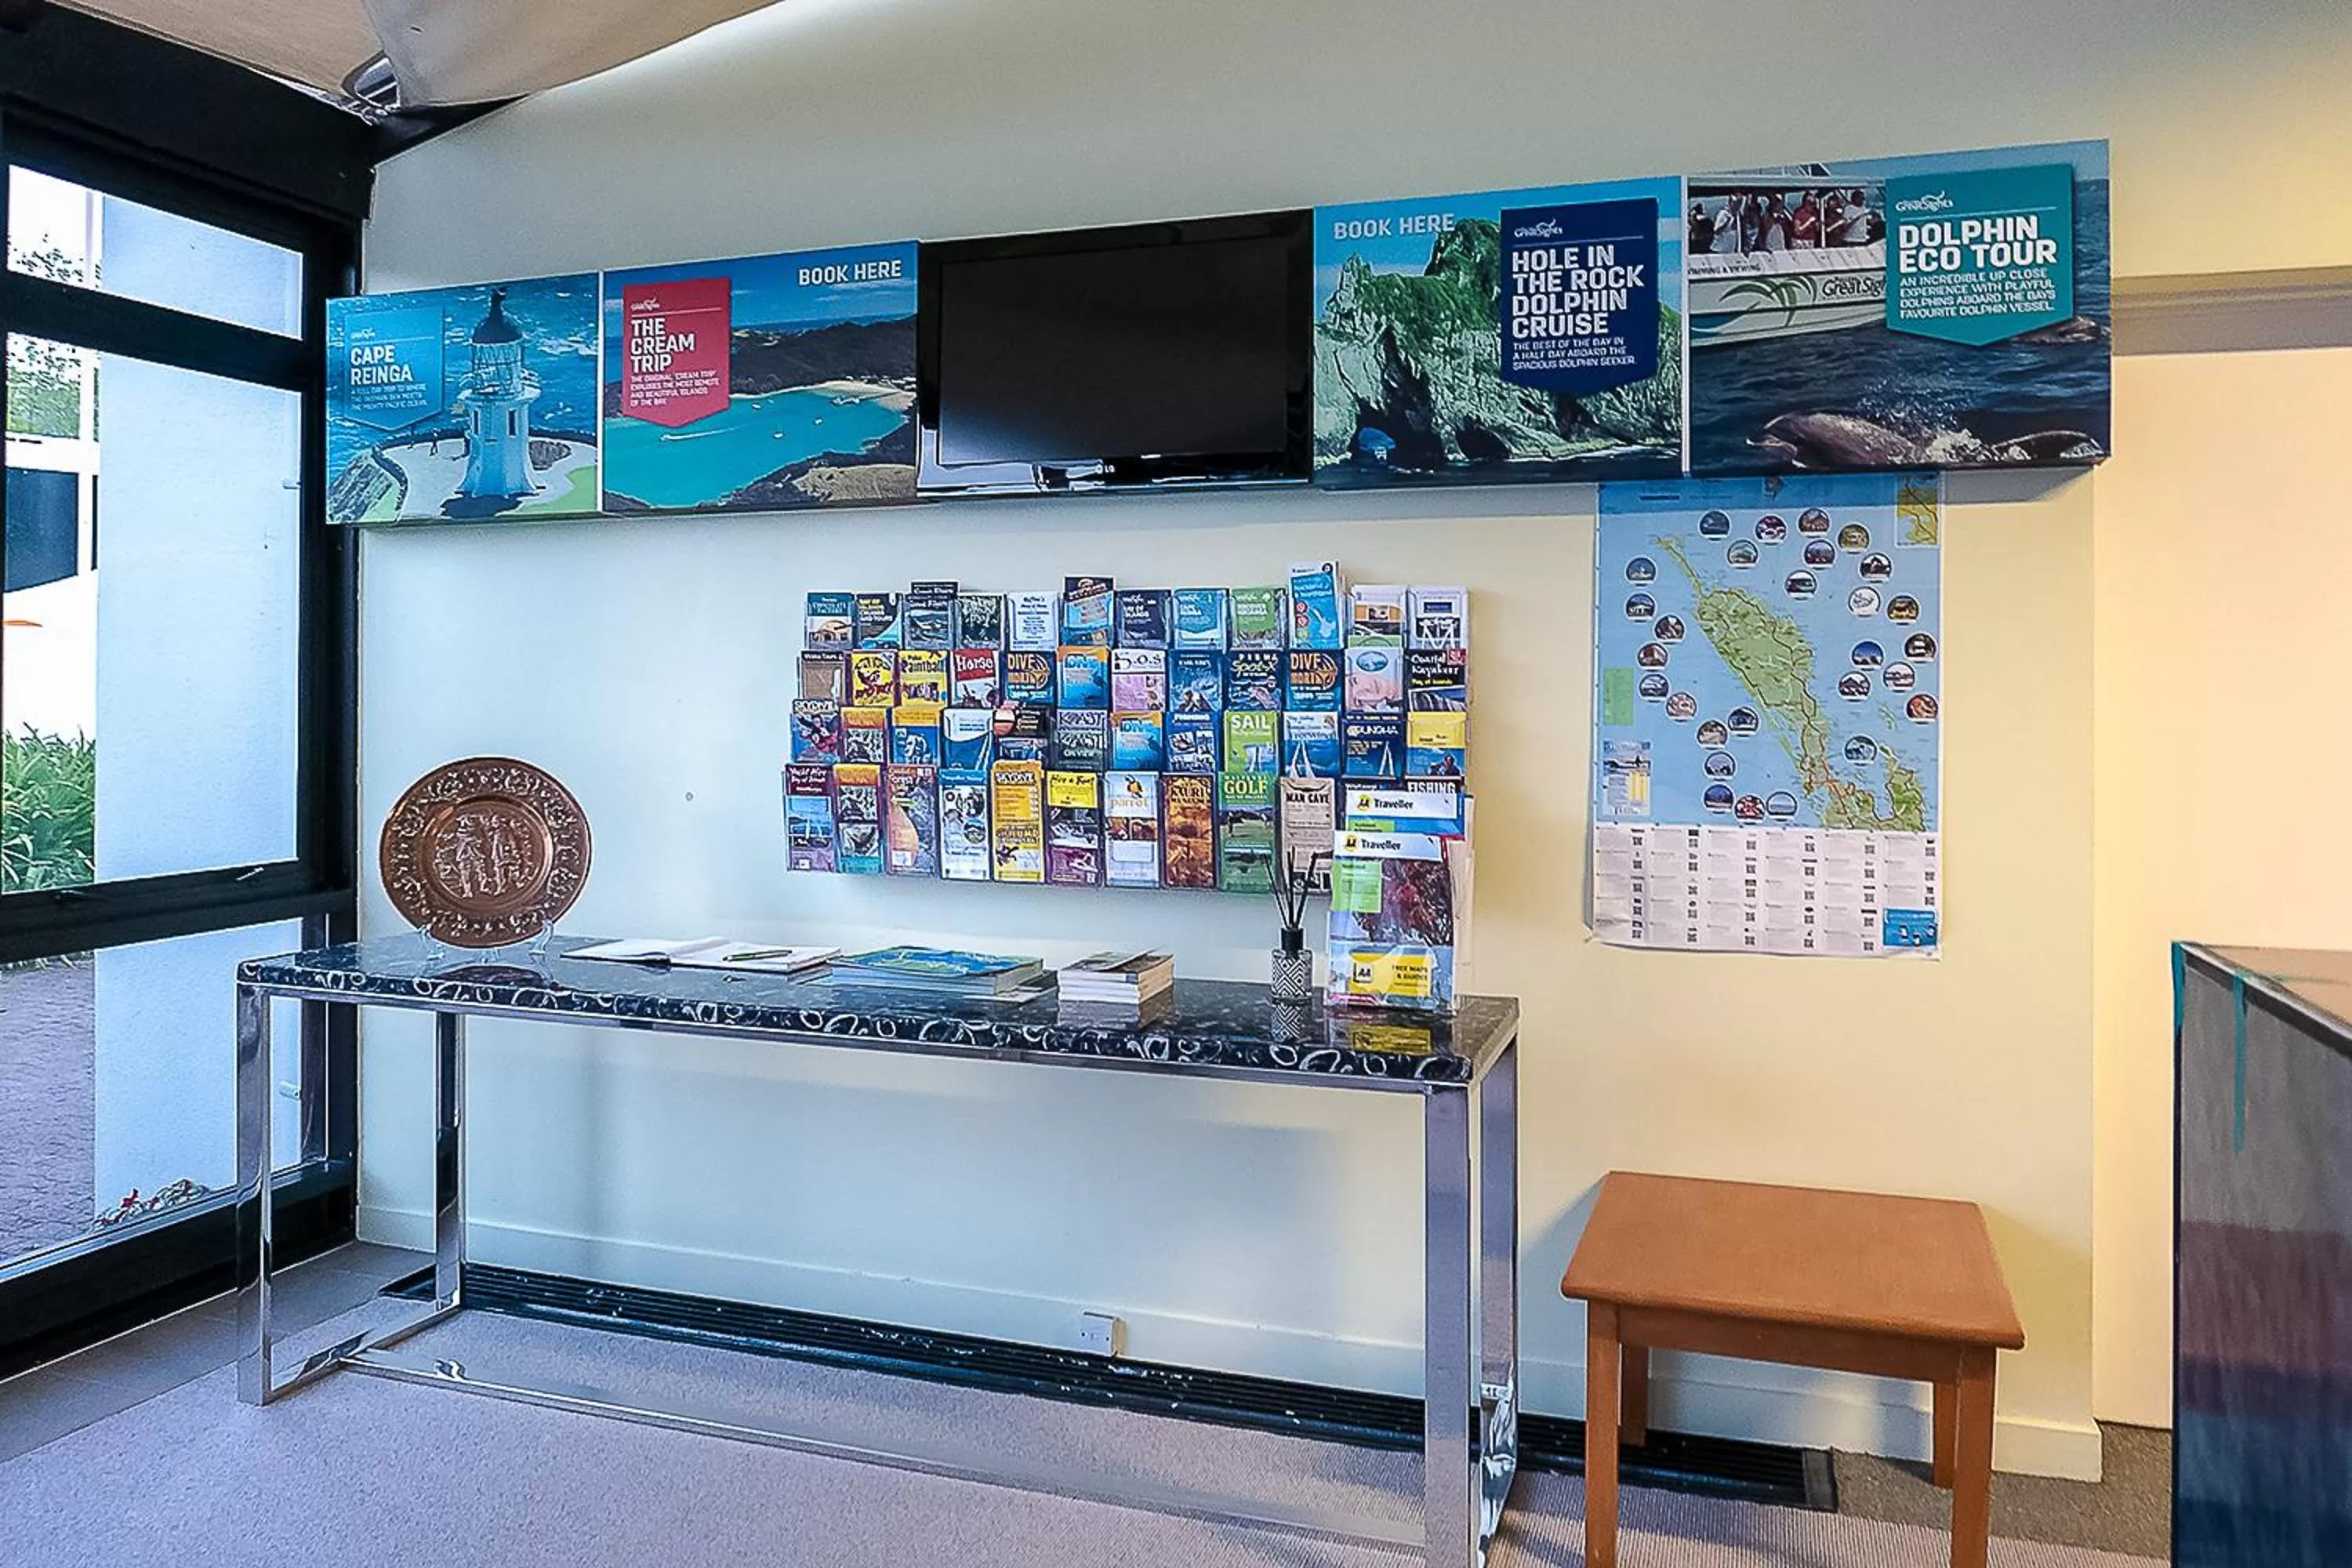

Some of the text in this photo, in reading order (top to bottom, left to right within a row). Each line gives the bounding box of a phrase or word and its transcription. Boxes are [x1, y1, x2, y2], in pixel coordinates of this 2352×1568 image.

[1334, 213, 1454, 239] BOOK HERE
[1899, 215, 2038, 249] DOLPHIN
[1512, 245, 1615, 272] HOLE IN
[1900, 239, 2058, 274] ECO TOUR
[799, 260, 902, 285] BOOK HERE
[1512, 264, 1645, 294] THE ROCK
[1900, 267, 2047, 287] AN INCREDIBLE UP CLOSE
[1900, 279, 2055, 298] EXPERIENCE WITH PLAYFUL
[1512, 289, 1627, 317] DOLPHIN
[1900, 289, 2056, 308] DOLPHINS ABOARD THE BAYS
[1900, 307, 1958, 320] FAVOURITE
[1960, 303, 2008, 316] DOLPHIN
[630, 318, 666, 336] THE
[1512, 313, 1609, 339] CRUISE
[630, 333, 695, 355] CREAM
[1513, 336, 1624, 350] THE BEST OF THE DAY IN
[350, 345, 395, 365] CAPE
[1513, 352, 1520, 361] A
[1522, 351, 1545, 360] HALF
[1568, 347, 1606, 358] ABOARD
[1610, 346, 1627, 355] THE
[630, 354, 672, 373] TRIP
[1513, 360, 1557, 371] SPACIOUS
[1559, 358, 1599, 368] DOLPHIN
[350, 364, 413, 385] REINGA
[955, 655, 993, 672] Horse
[1007, 654, 1035, 670] DIVE
[1290, 654, 1320, 670] DIVE
[1231, 715, 1270, 728] SAIL
[1224, 781, 1268, 794] GOLF
[1286, 793, 1330, 803] MAN CAVE
[1374, 799, 1414, 809] Traveller
[1361, 839, 1401, 850] Traveller
